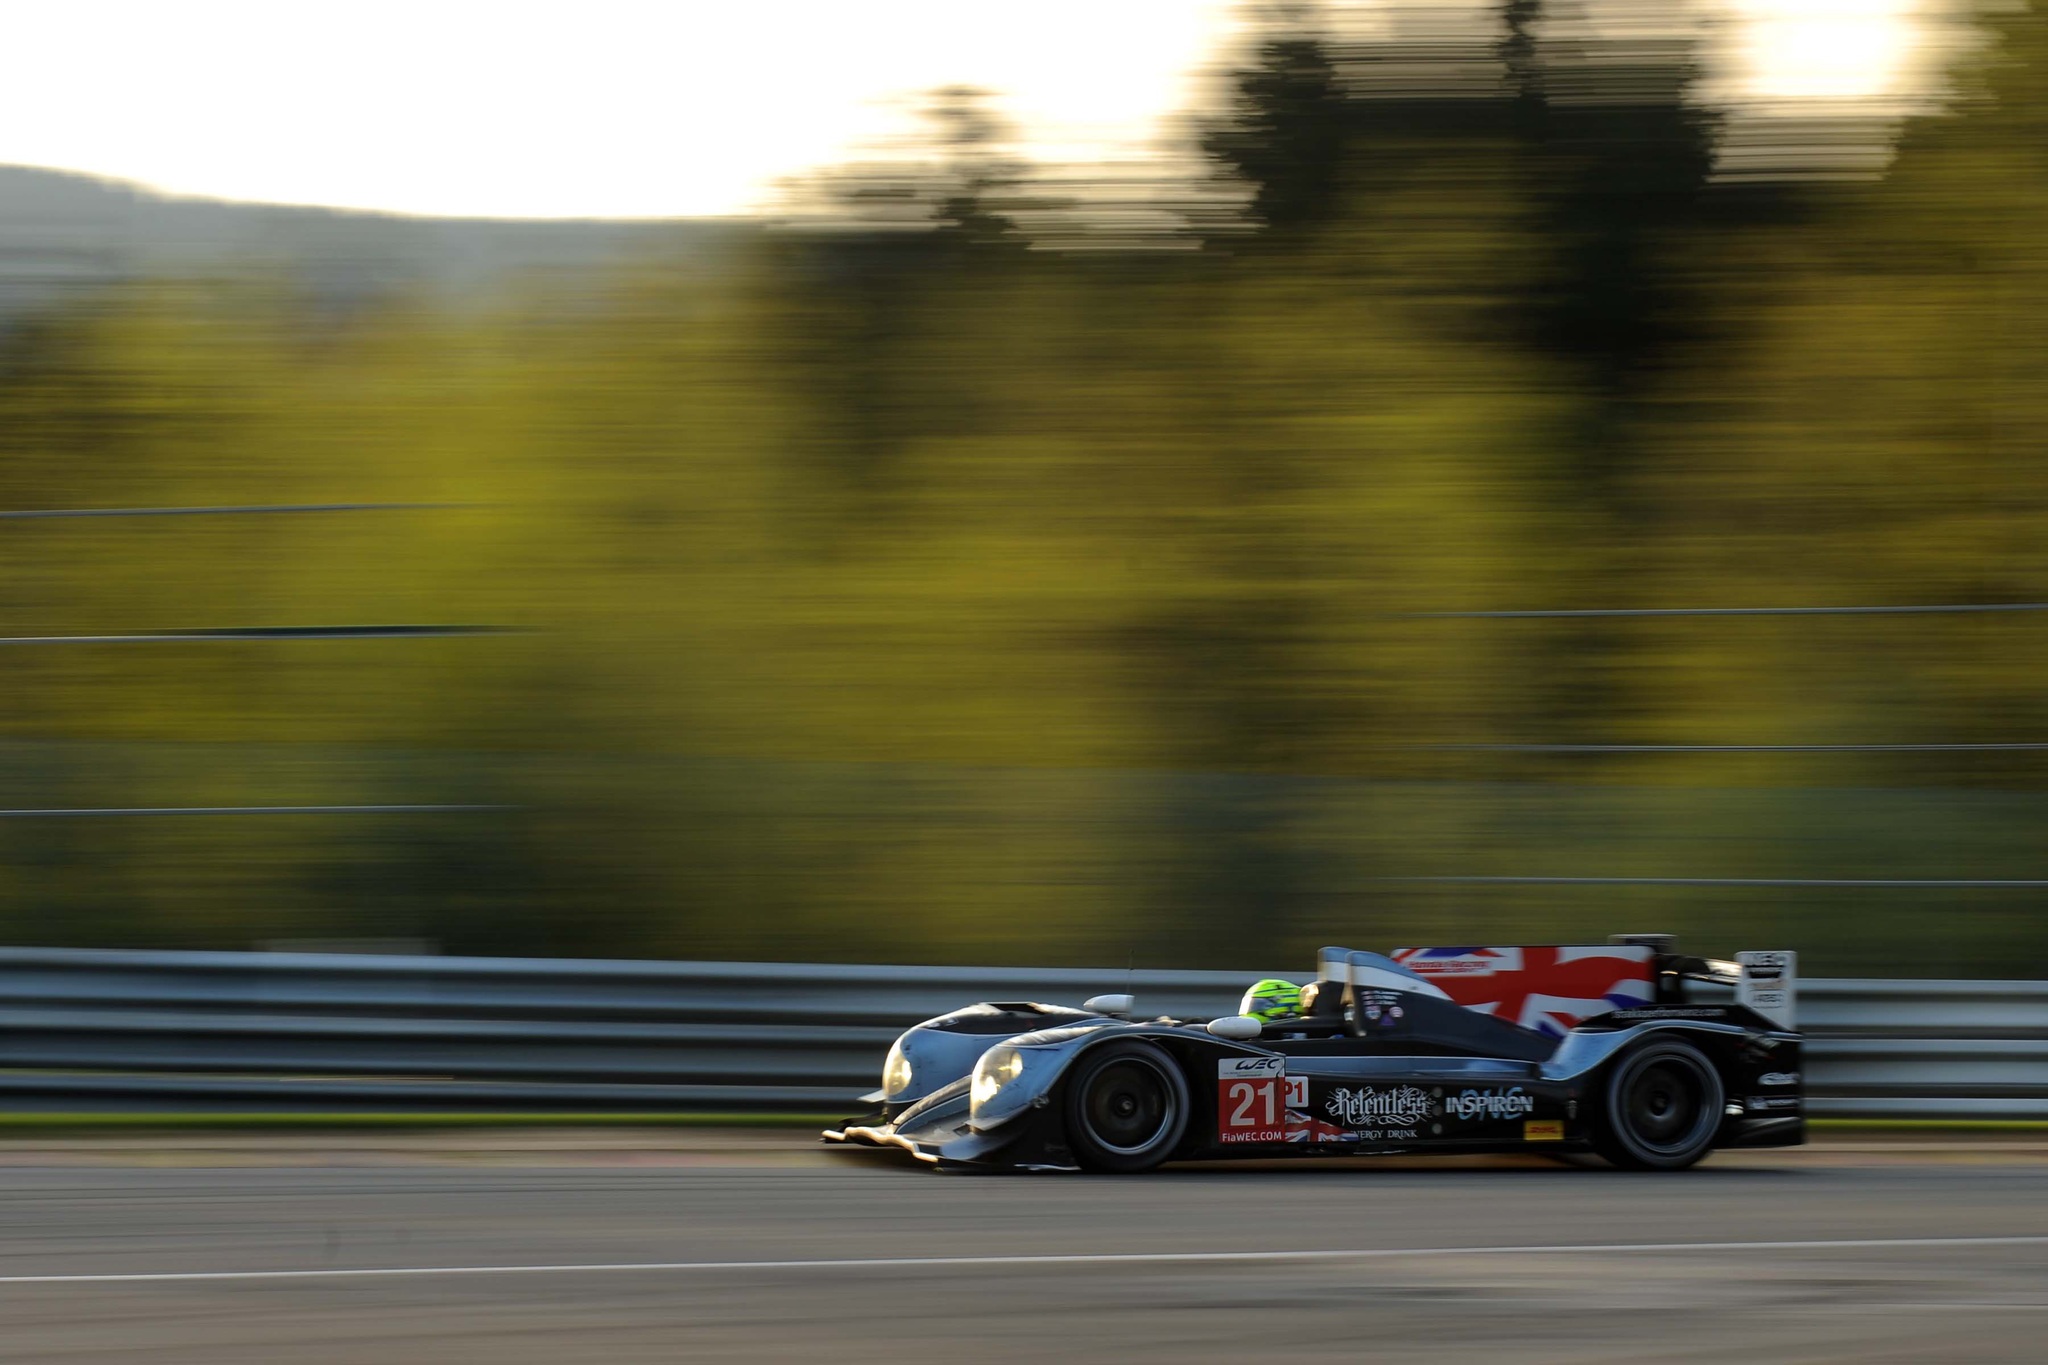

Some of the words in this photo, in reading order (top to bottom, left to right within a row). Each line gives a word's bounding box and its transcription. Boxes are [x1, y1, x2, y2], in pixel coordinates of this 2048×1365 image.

[1235, 1058, 1279, 1070] WEC
[1285, 1081, 1303, 1103] P1
[1229, 1082, 1275, 1126] 21
[1326, 1084, 1433, 1126] Relentless
[1445, 1096, 1534, 1113] INSPIRON
[1222, 1131, 1282, 1142] FiaWEC.COM
[1387, 1129, 1418, 1140] DRINK
